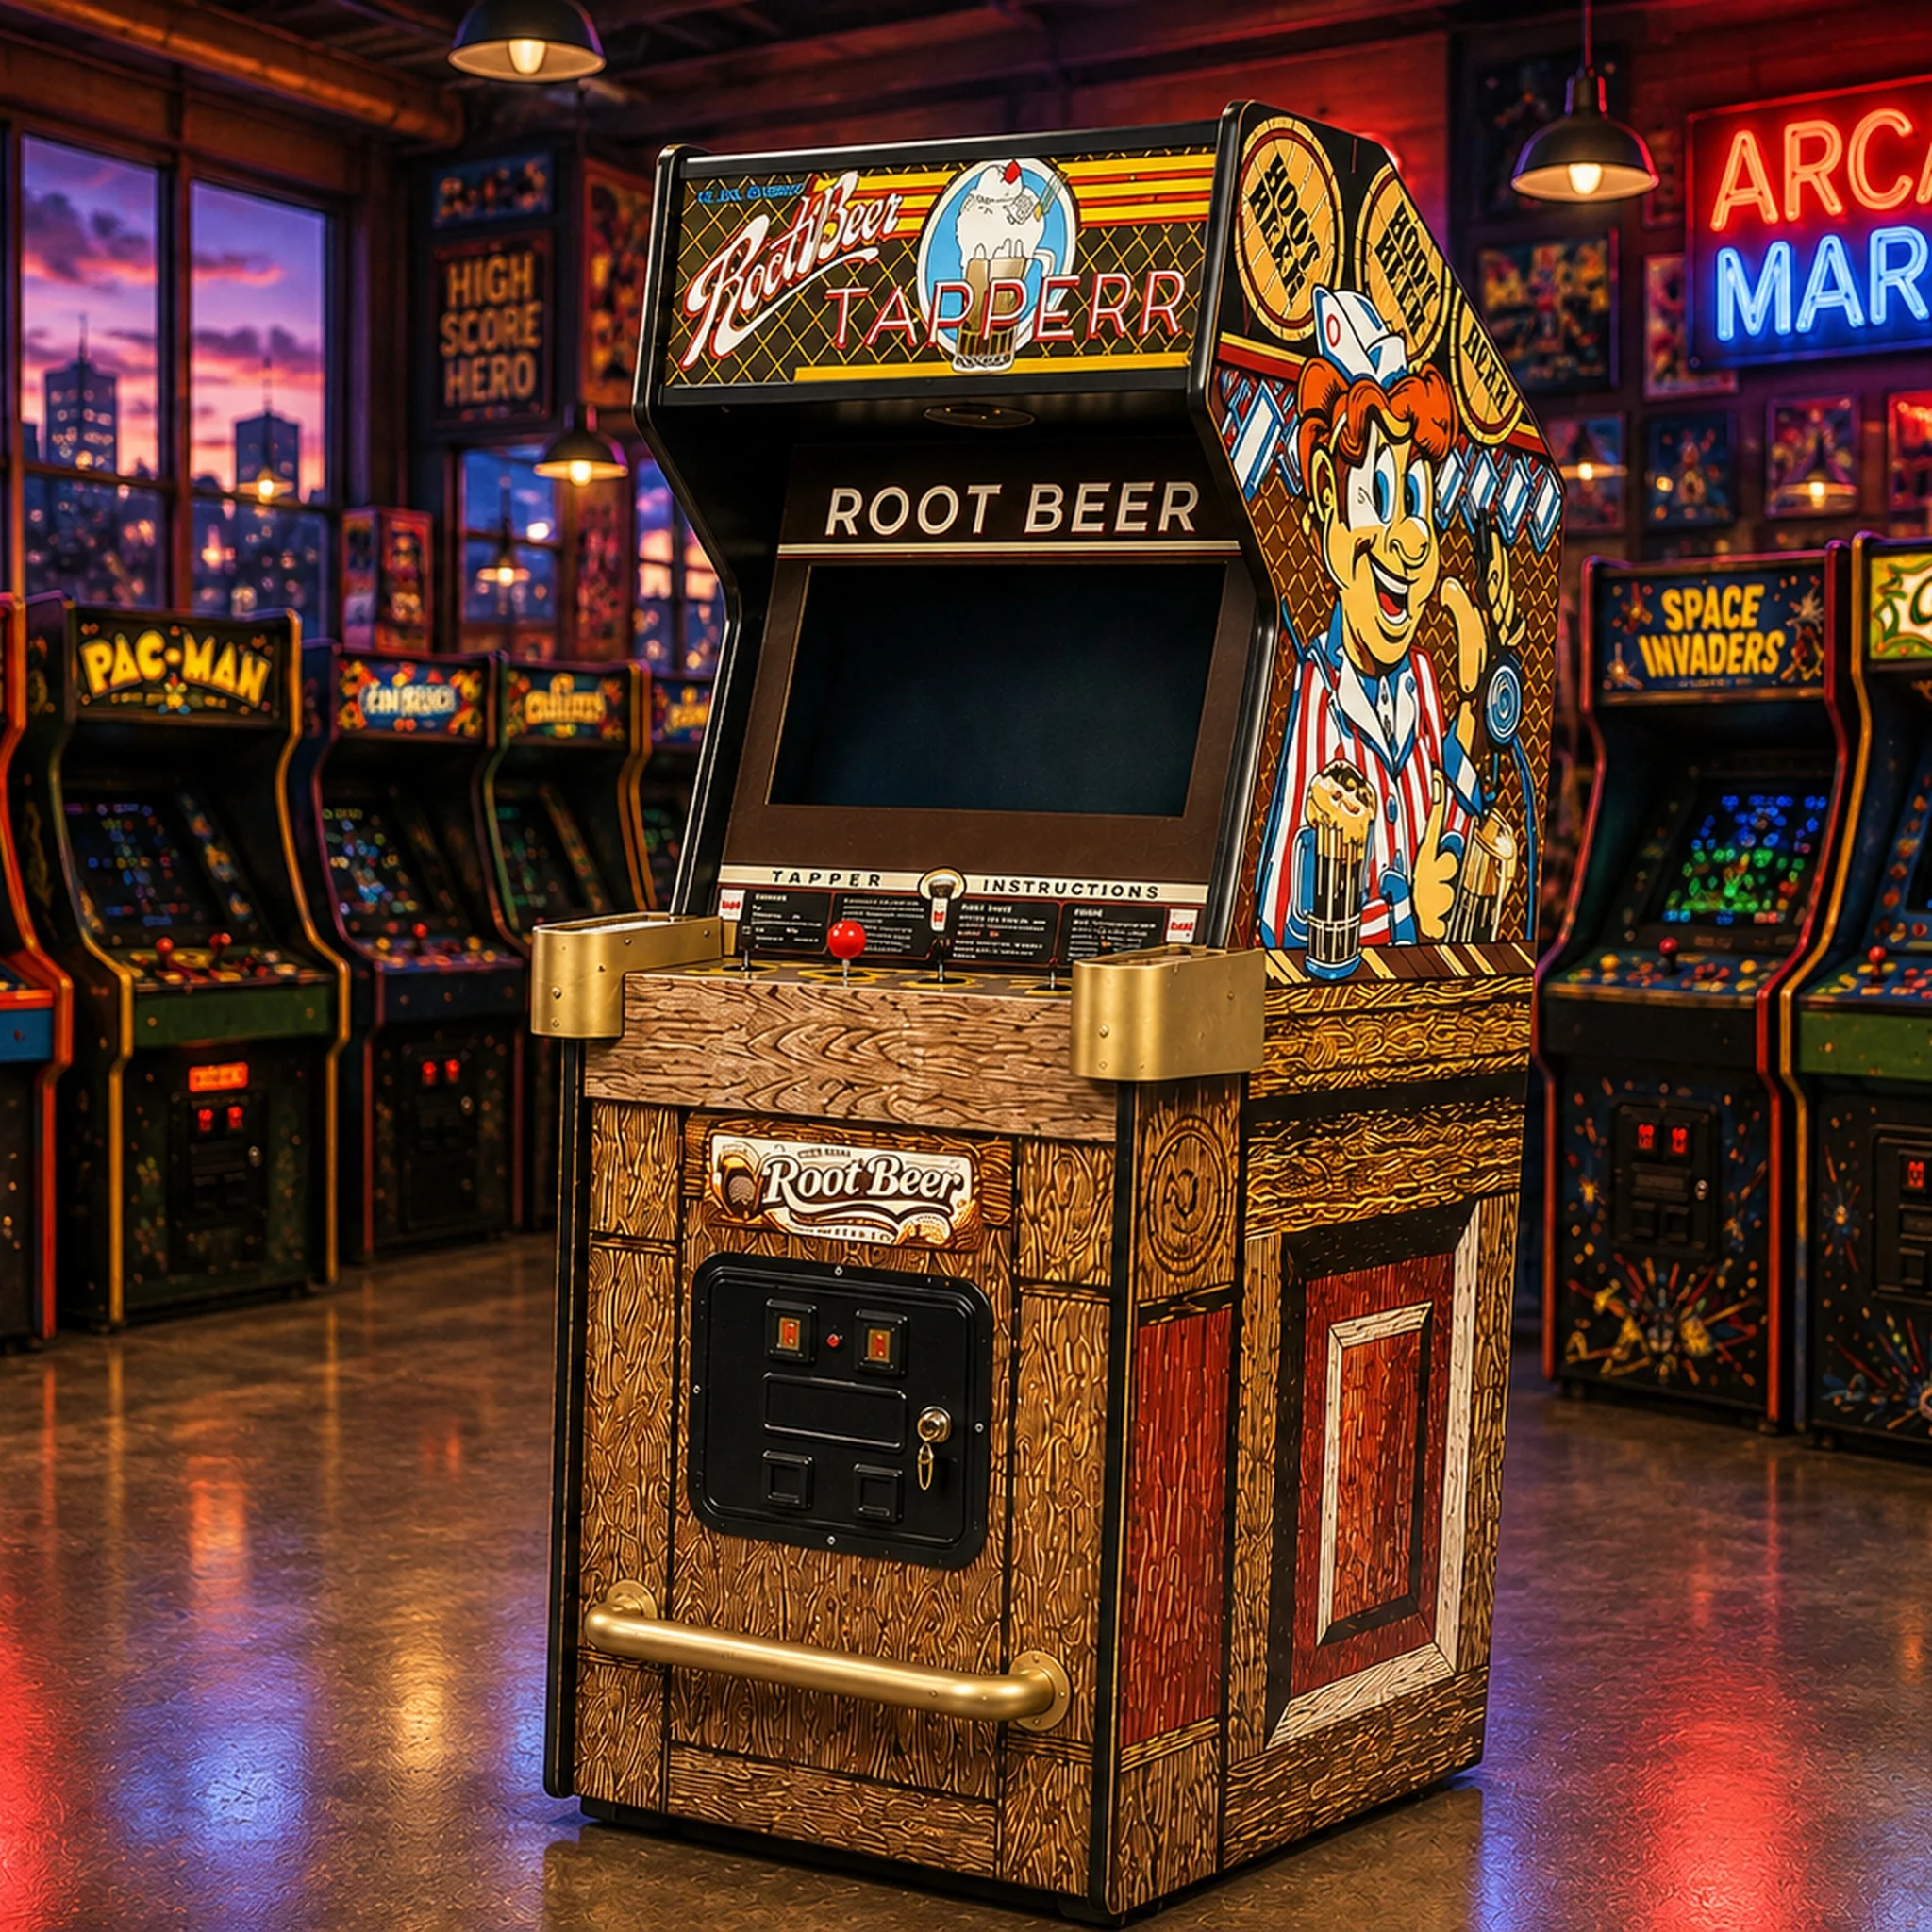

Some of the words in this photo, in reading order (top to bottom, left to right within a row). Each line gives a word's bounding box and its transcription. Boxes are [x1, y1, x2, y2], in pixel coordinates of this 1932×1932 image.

[1710, 108, 1932, 231] ARC
[447, 250, 535, 308] HIGH
[1716, 226, 1930, 341] MAR
[440, 300, 543, 358] SCORE
[824, 270, 1187, 350] TAPPERR
[444, 350, 536, 406] HERO
[825, 483, 1002, 535] ROOT
[1024, 481, 1199, 533] BEER
[1661, 584, 1765, 633] SPACE
[1637, 629, 1785, 677] INVADERS
[771, 869, 882, 888] TAPPER
[983, 878, 1158, 899] INSTRUCTIONS
[761, 1155, 864, 1206] Root
[866, 1153, 964, 1201] Beer
